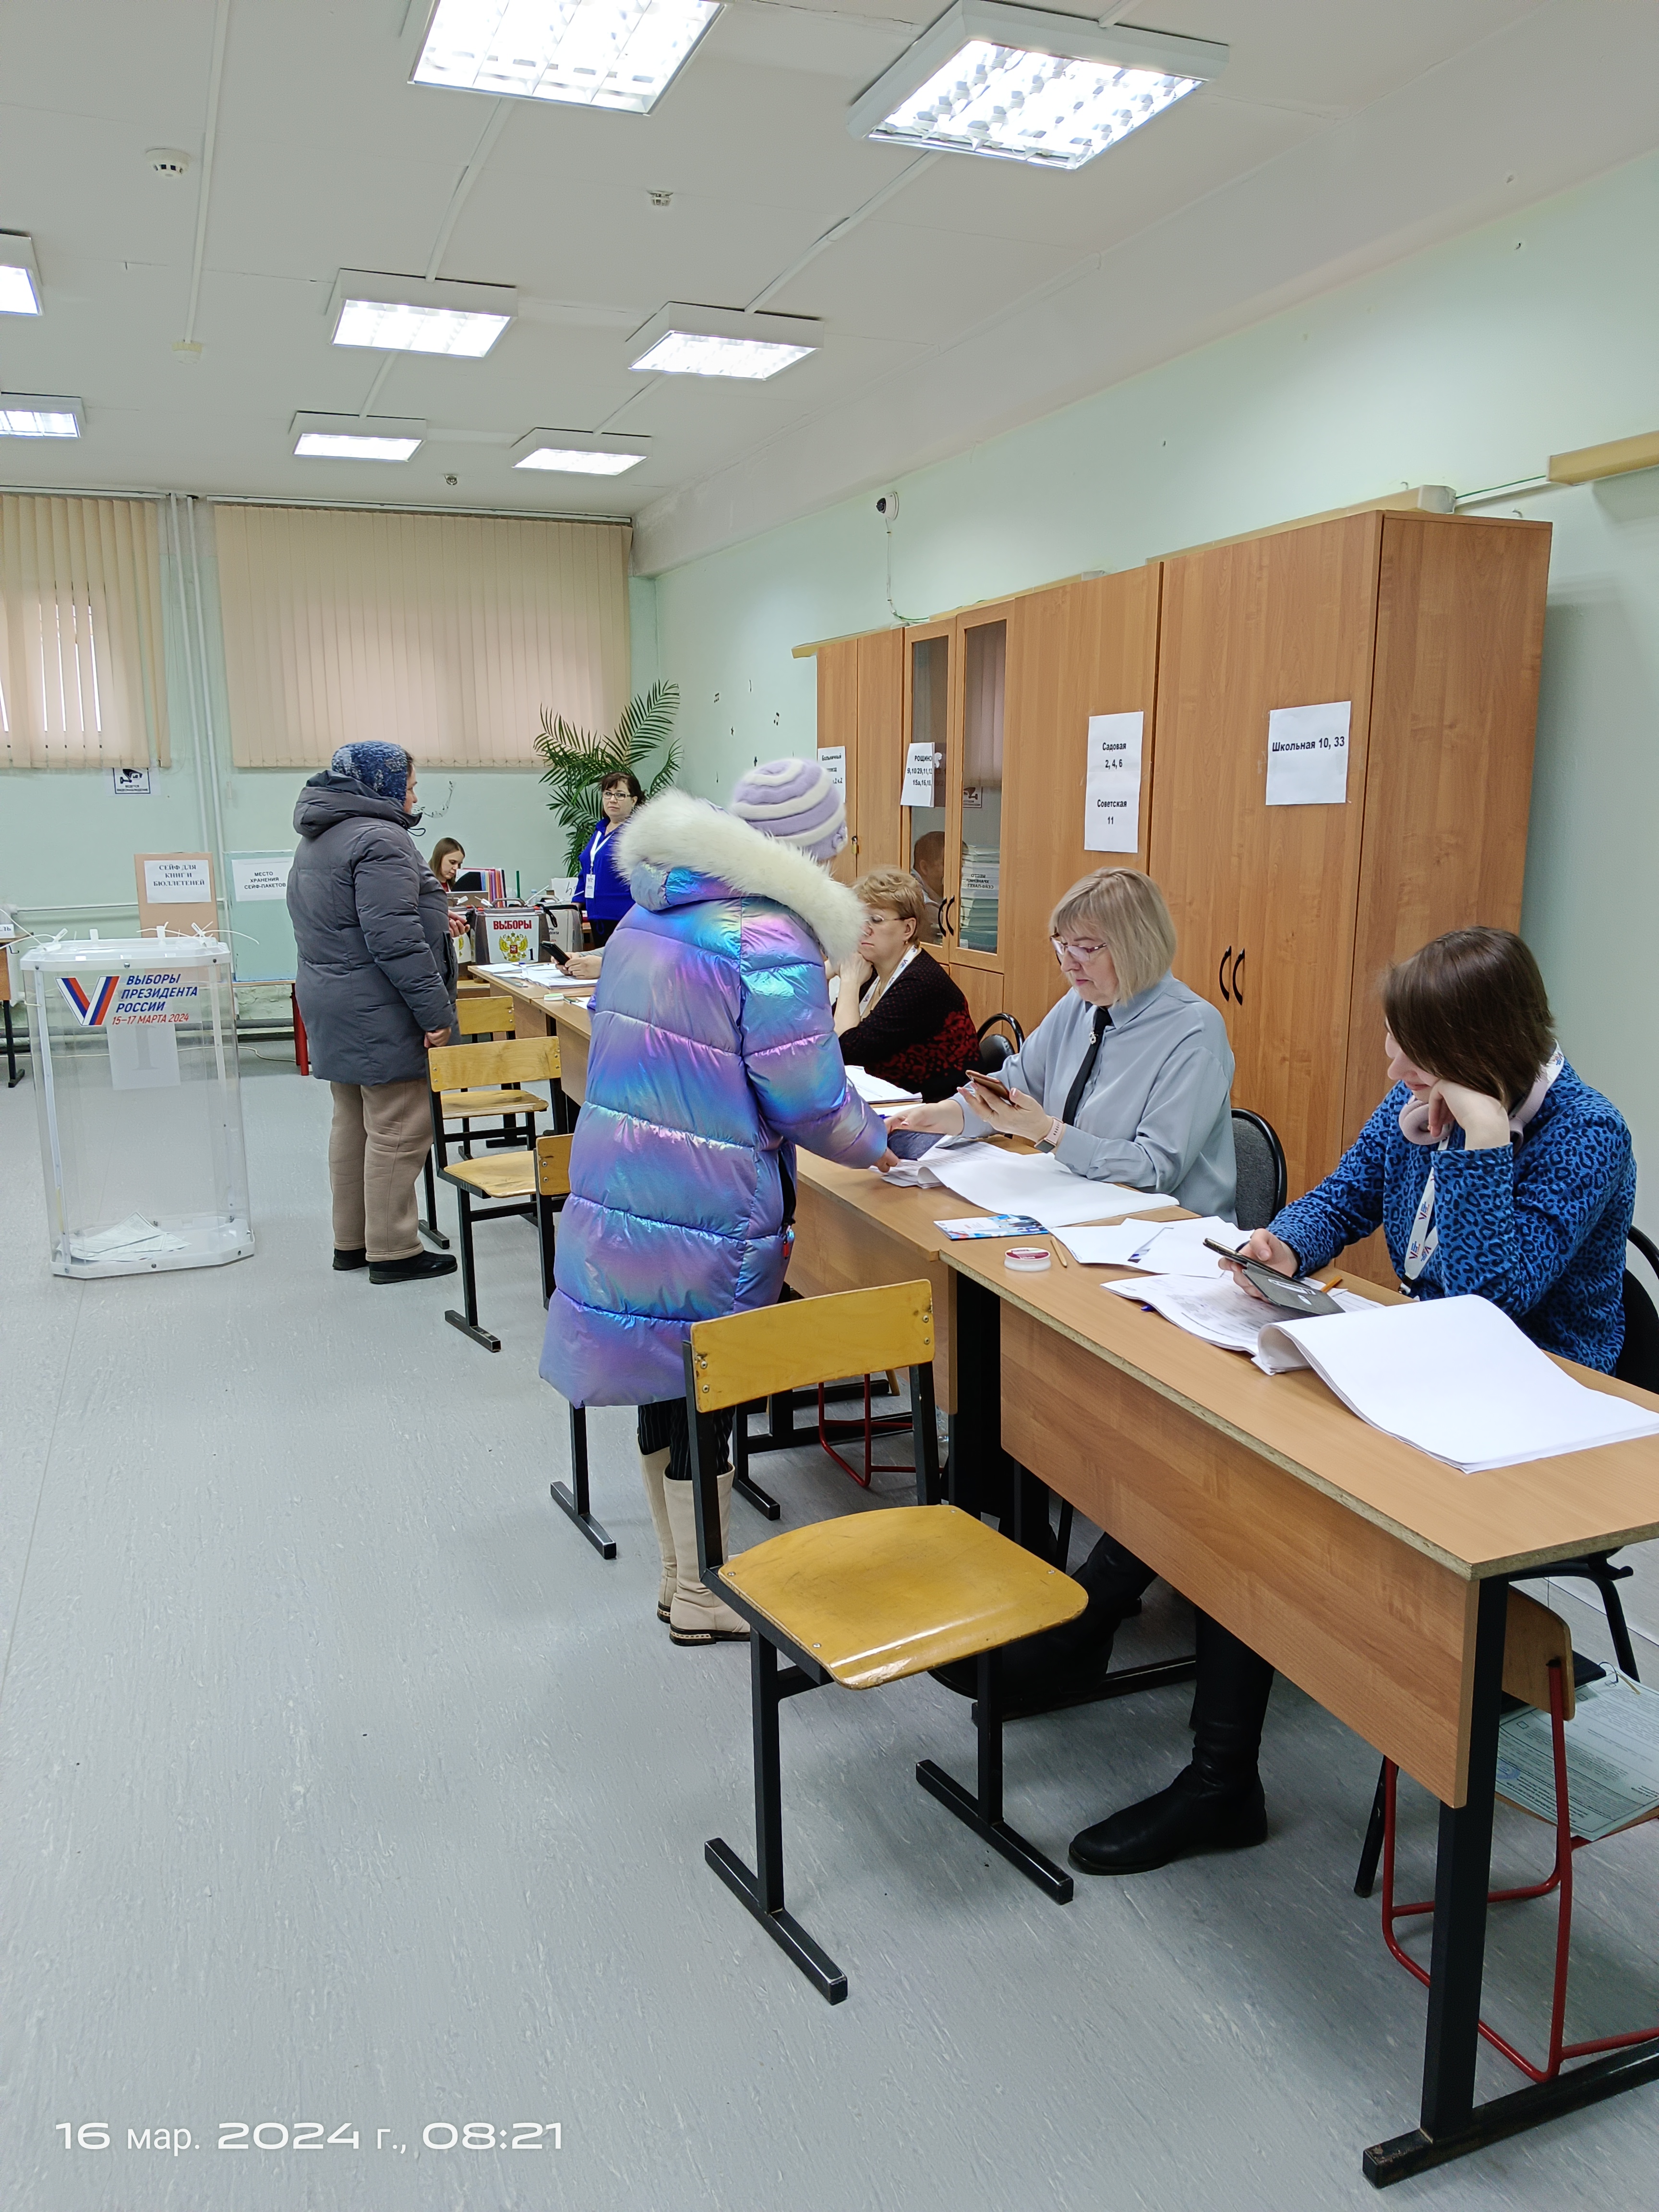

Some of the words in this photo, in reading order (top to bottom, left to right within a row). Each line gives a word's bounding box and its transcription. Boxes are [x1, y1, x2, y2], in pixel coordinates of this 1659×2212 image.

[1102, 742, 1126, 752] Садовая
[1272, 742, 1315, 752] Школьная
[1319, 737, 1331, 750] 10,
[1334, 736, 1345, 747] 33
[1105, 759, 1110, 769] 2,
[1112, 759, 1118, 769] 4,
[1119, 759, 1123, 768] 6
[1097, 799, 1127, 807] Советская
[1107, 816, 1114, 824] 11
[493, 920, 532, 930] ВЫБОРЫ
[528, 948, 535, 961] 1
[126, 974, 181, 985] ВЫБОРЫ
[121, 986, 198, 999] ПРЕЗИДЕНТА
[116, 1001, 166, 1013] РОССИИ
[137, 1014, 167, 1024] МАРТА
[168, 1013, 189, 1022] 2024
